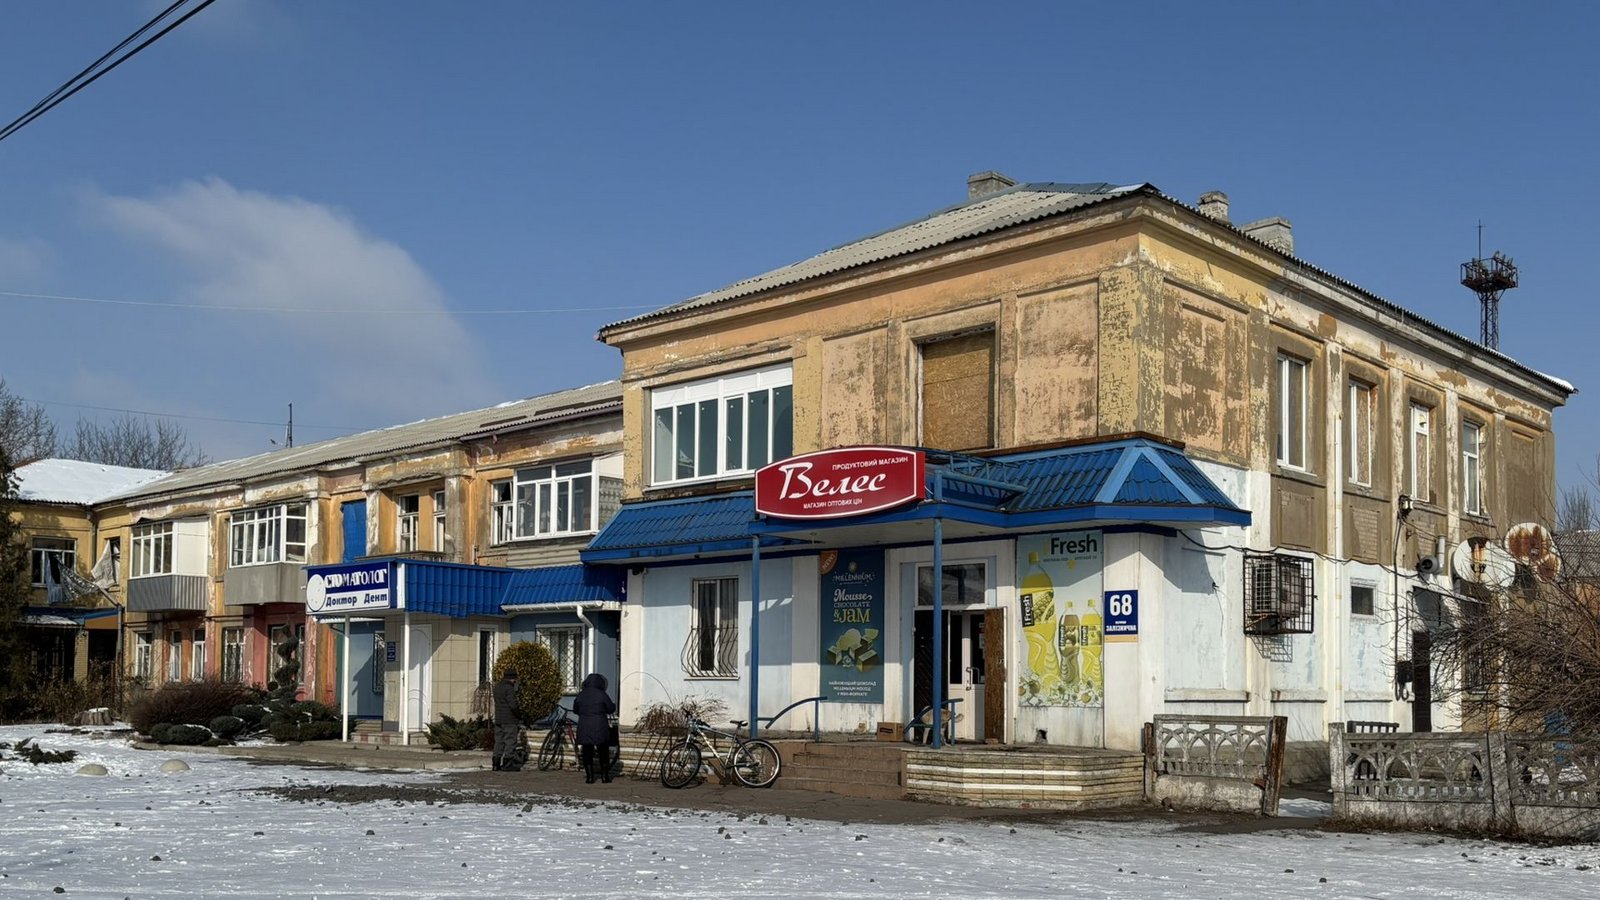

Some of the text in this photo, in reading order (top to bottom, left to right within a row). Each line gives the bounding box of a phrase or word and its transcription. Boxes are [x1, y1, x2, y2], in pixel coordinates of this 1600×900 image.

[832, 456, 909, 470] ПРОДУКТОВИЙ МАГАЗИН
[778, 461, 887, 500] Велес
[803, 501, 827, 509] МАГАЗИН
[827, 499, 853, 507] ОПТОВИХ
[324, 569, 387, 588] СТОМАТОЛОГ
[326, 593, 387, 608] Доктор Дент
[833, 588, 872, 602] Mousse
[1109, 593, 1133, 616] 68
